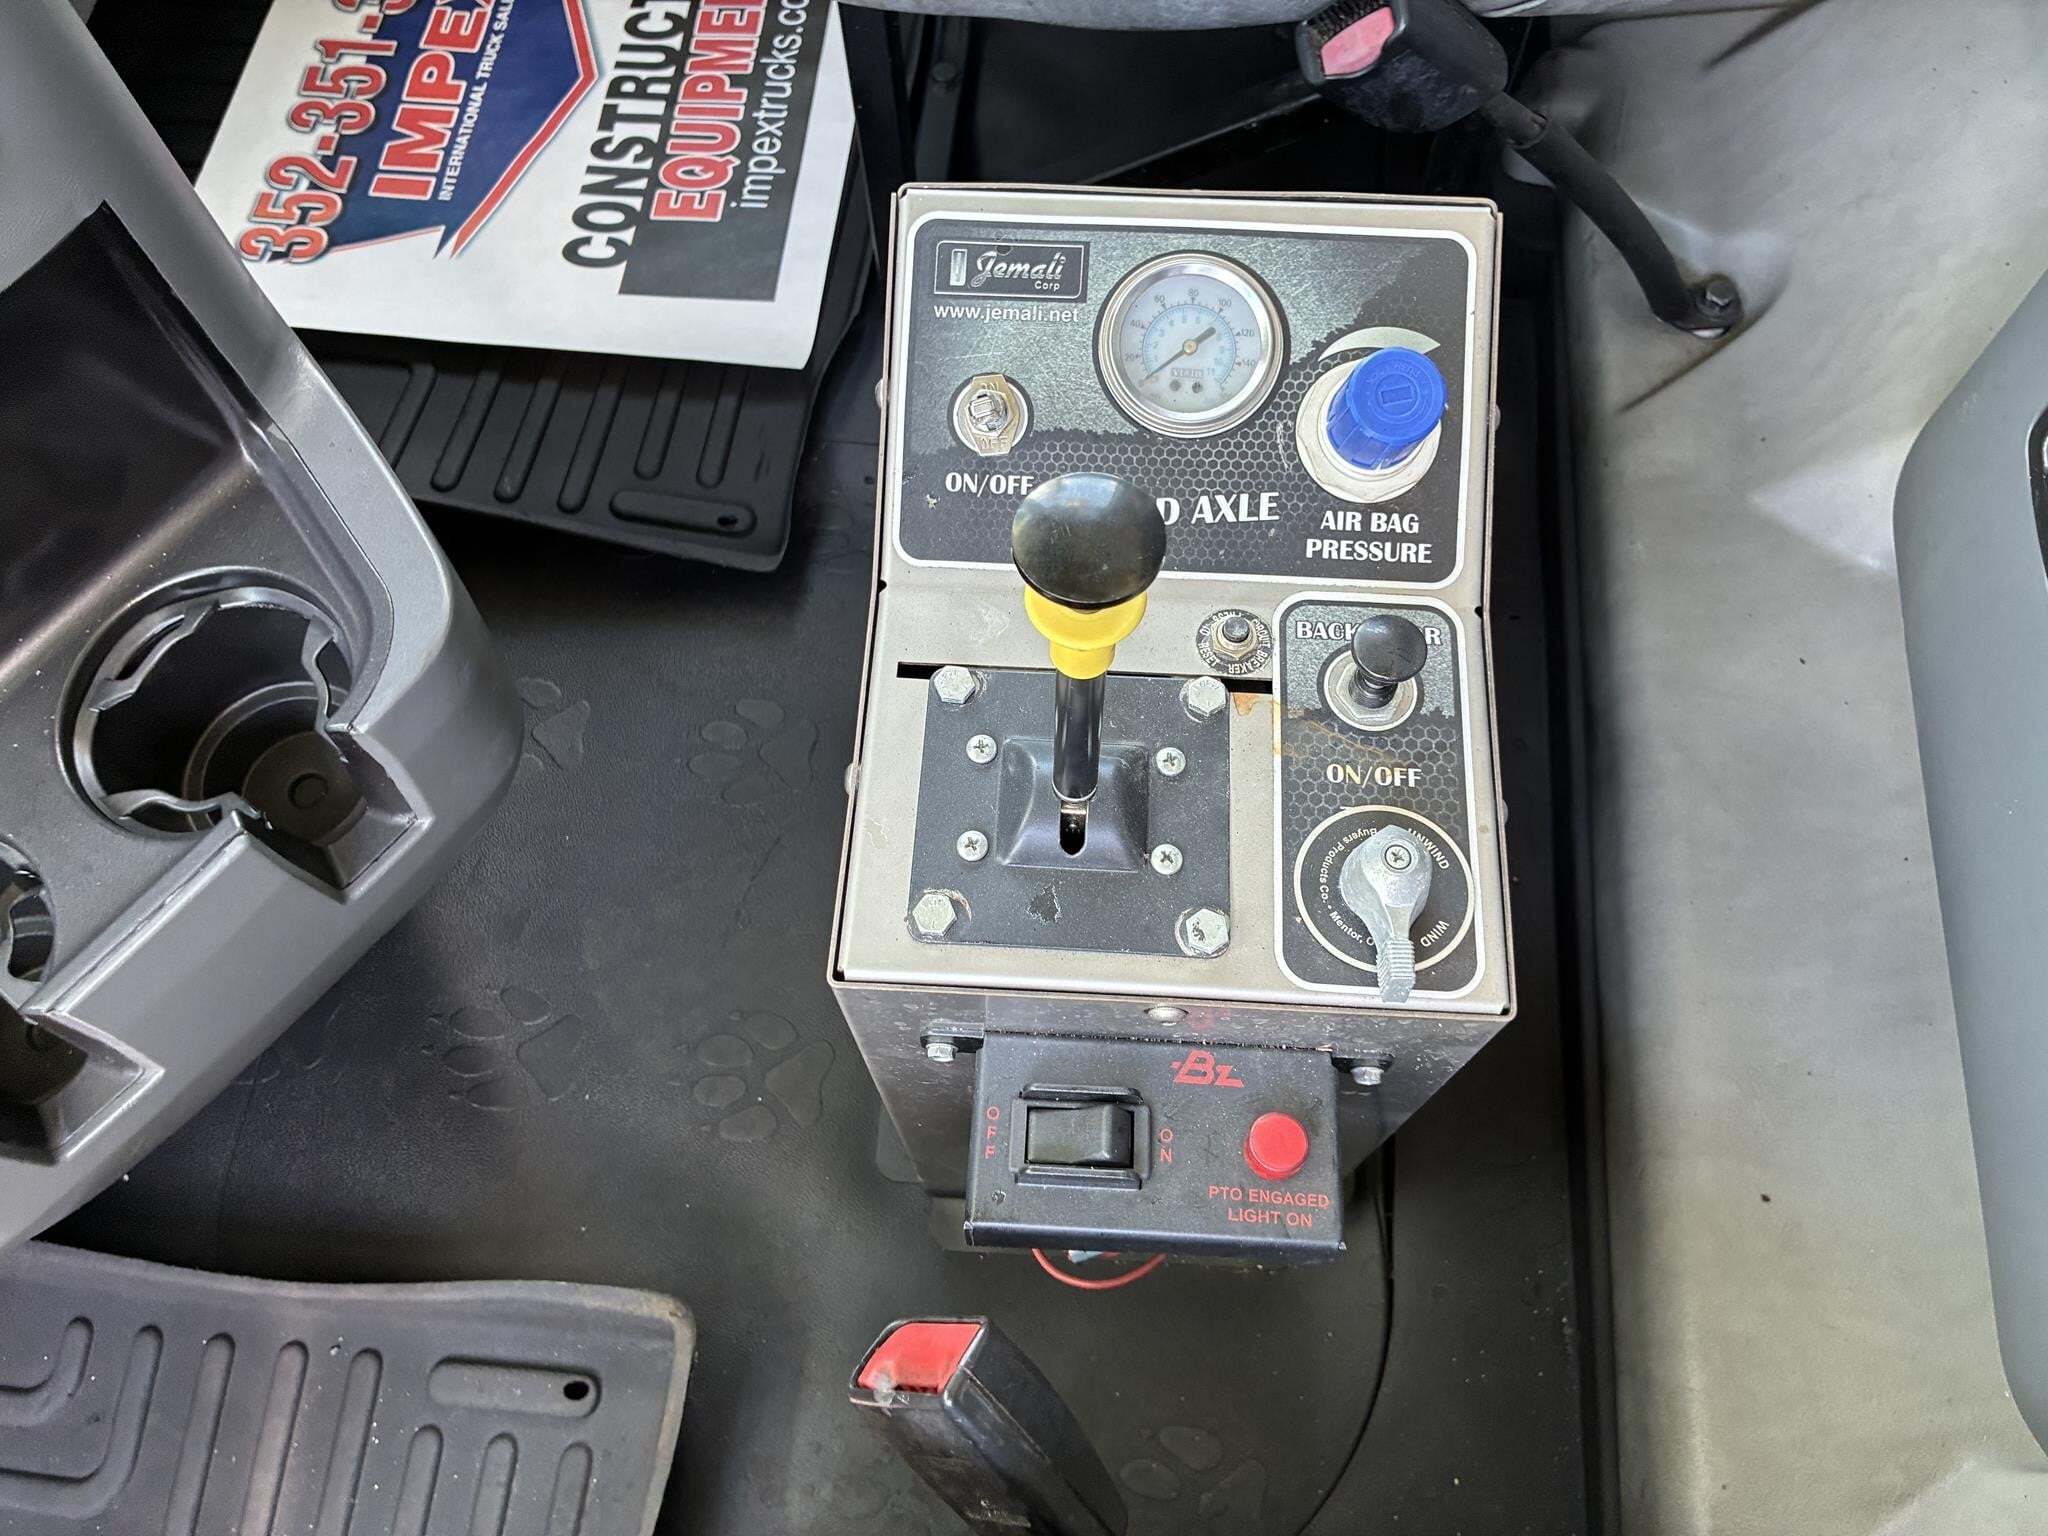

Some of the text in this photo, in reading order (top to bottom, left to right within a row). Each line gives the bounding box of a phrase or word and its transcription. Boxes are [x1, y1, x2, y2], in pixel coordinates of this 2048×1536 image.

[368, 0, 494, 200] IMPE
[438, 82, 488, 201] INTERNATIONAL
[475, 33, 505, 80] TRUCK
[971, 251, 1067, 288] Jemali
[1034, 280, 1061, 292] Corp
[933, 304, 1080, 323] www.jemali.net
[1217, 298, 1232, 307] 100
[1130, 319, 1141, 328] 40
[1240, 328, 1255, 337] 120
[945, 471, 1035, 497] ON/OFF
[1191, 492, 1280, 524] AXLE
[1320, 510, 1419, 533] AIR BAG
[1306, 539, 1432, 564] PRESSURE
[1198, 639, 1218, 667] RESET
[1228, 618, 1271, 674] CIRCUIT BREAKER
[1326, 763, 1423, 788] ON/OFF
[1343, 827, 1378, 845] Buyers
[1319, 841, 1346, 884] Products
[1319, 885, 1330, 903] Co.
[1329, 910, 1364, 944] Mentor,
[1420, 920, 1451, 948] WIND
[1158, 1128, 1175, 1163] ON
[1207, 1185, 1331, 1210] PTO ENGAGED
[1227, 1207, 1314, 1227] LIGHT ON
